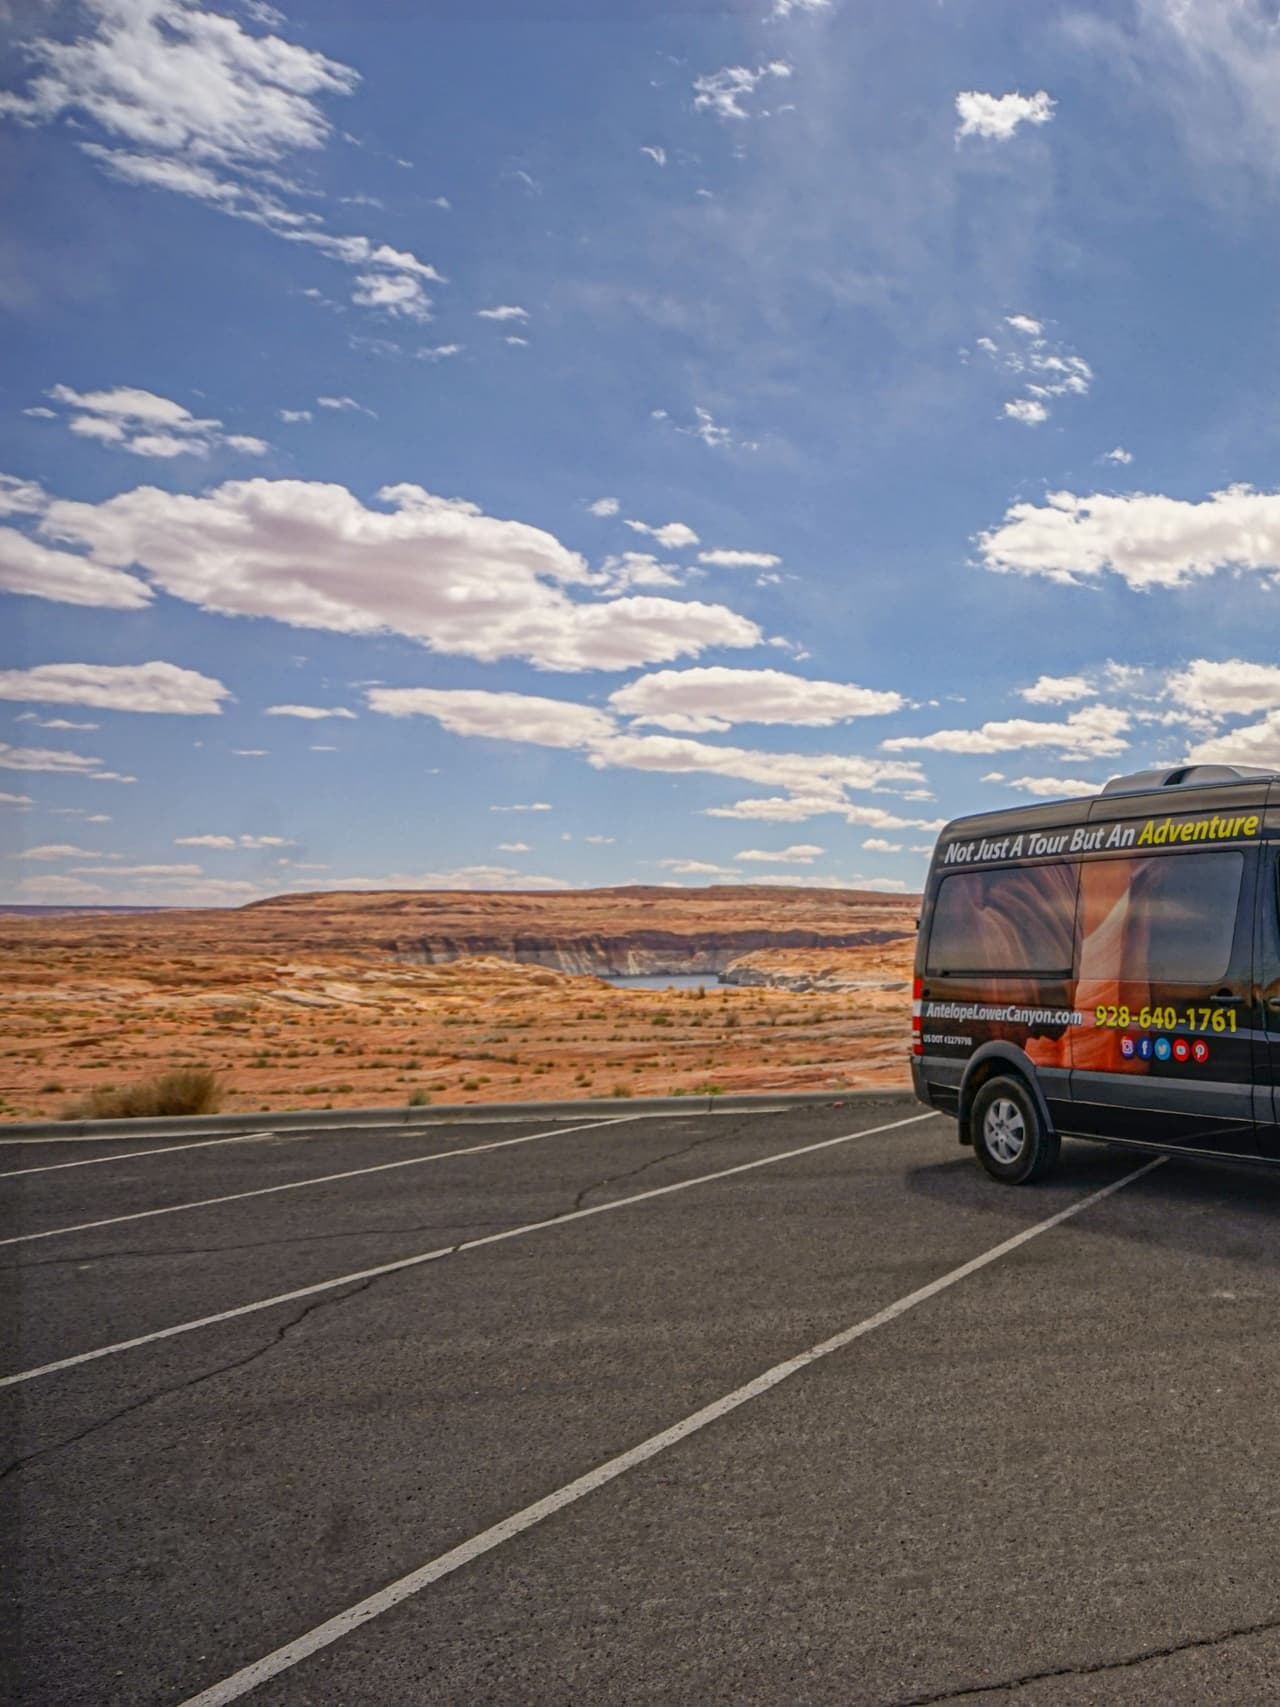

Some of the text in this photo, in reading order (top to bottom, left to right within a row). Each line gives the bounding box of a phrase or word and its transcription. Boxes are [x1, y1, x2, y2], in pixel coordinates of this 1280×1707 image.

[944, 815, 1258, 864] Not Just A Tour But An Adventure
[926, 1002, 1083, 1028] AntelopeLowerCanyon.com
[1095, 1005, 1237, 1032] 928-640-1761
